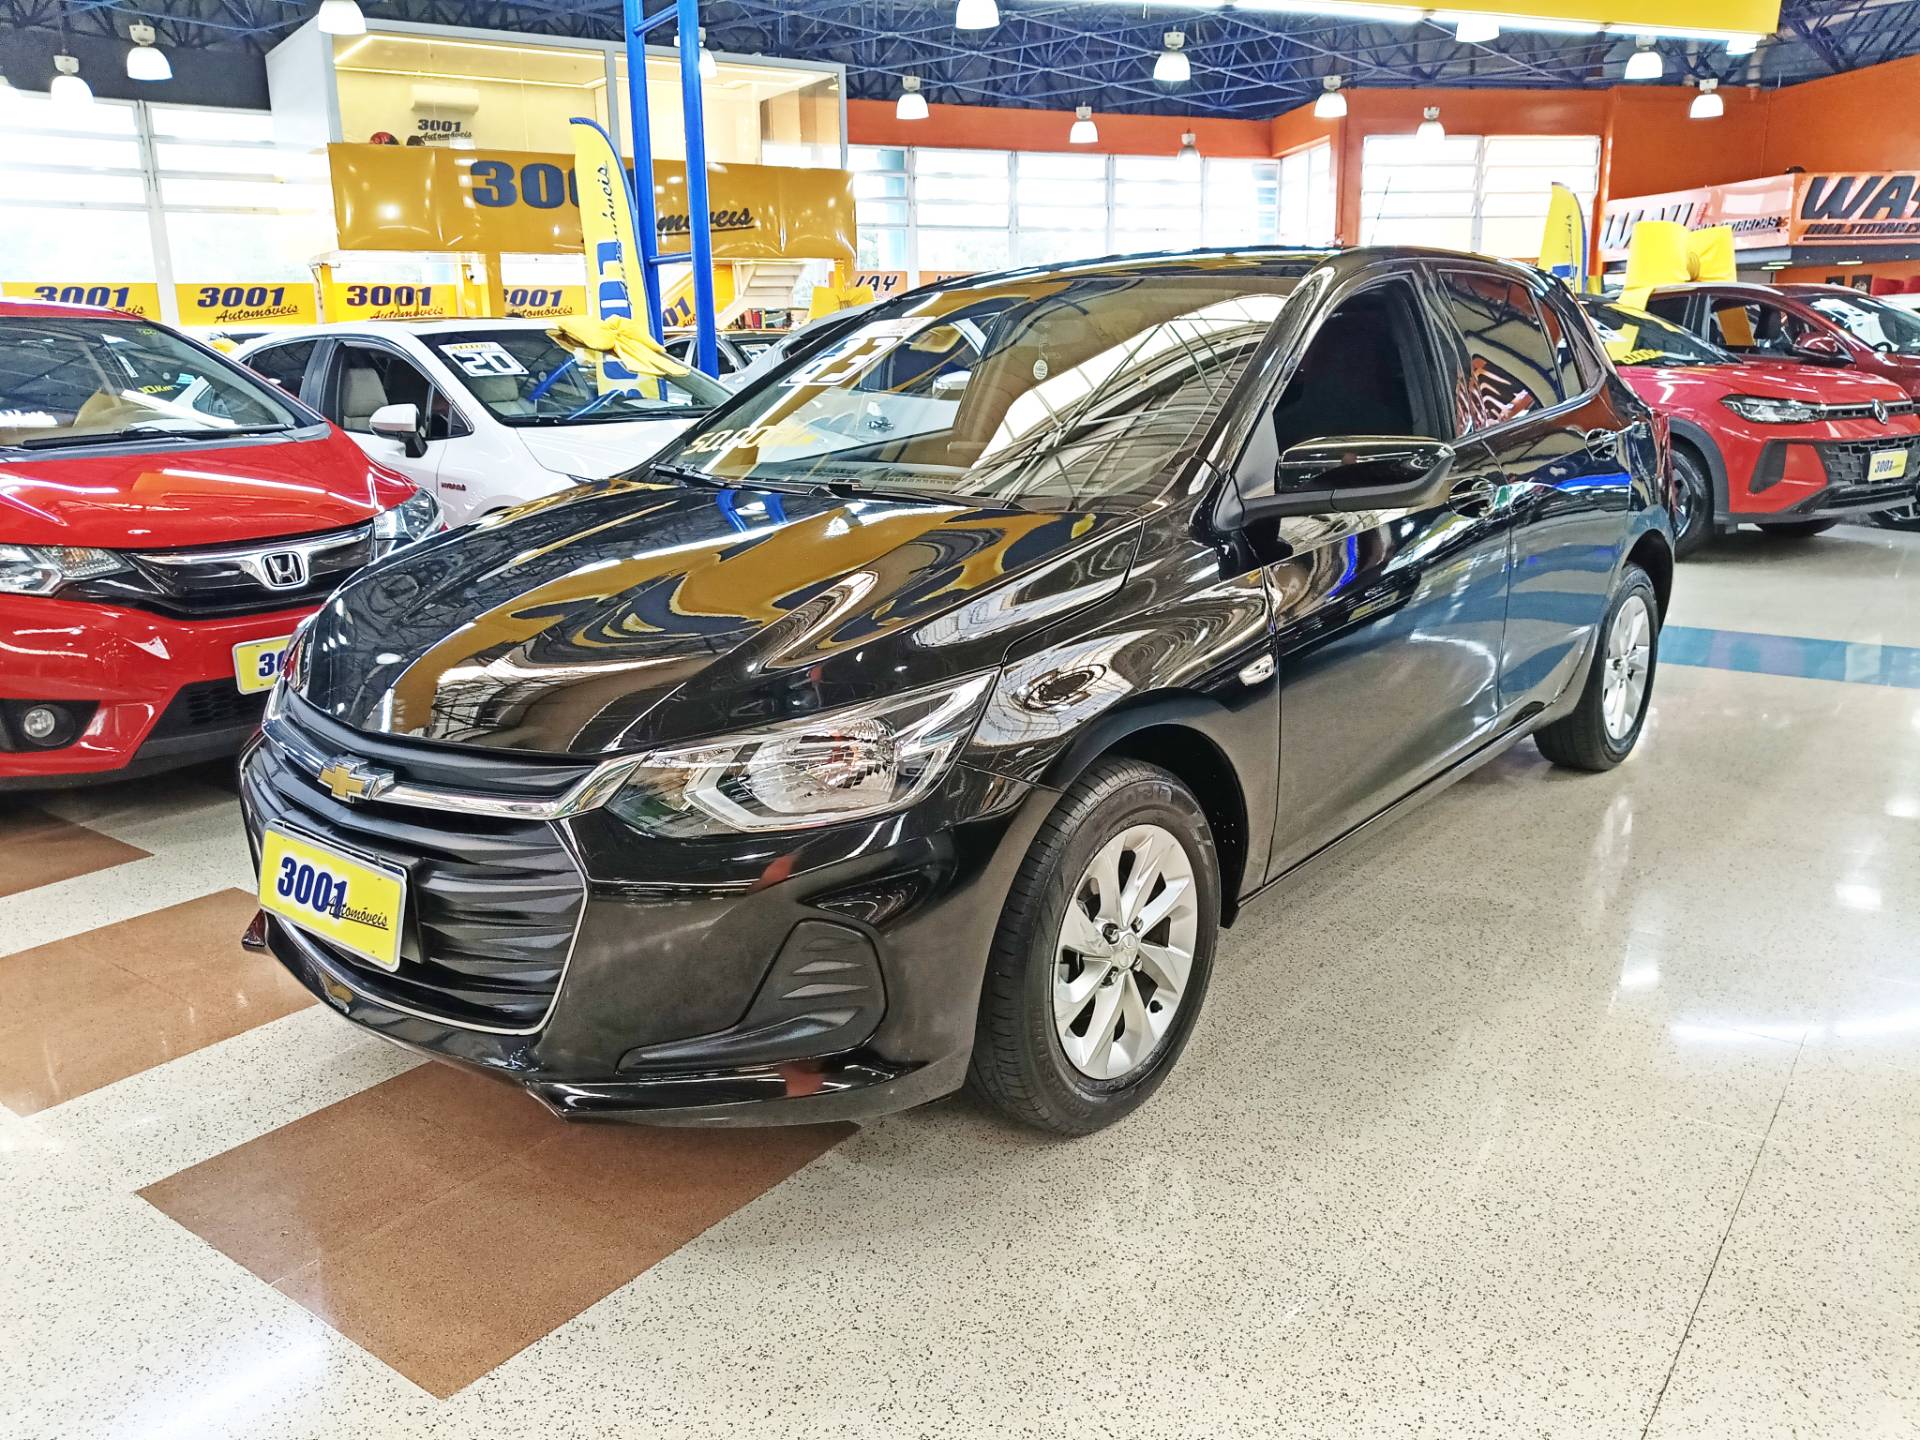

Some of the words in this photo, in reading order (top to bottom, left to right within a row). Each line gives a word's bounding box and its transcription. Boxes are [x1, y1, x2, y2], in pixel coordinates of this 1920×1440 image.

[418, 119, 461, 132] 3001
[1801, 175, 1920, 219] WA
[856, 275, 898, 291] AY
[197, 287, 285, 307] 3001
[346, 286, 432, 306] 3001
[215, 304, 299, 323] Automóveis
[662, 296, 691, 326] 01
[453, 352, 524, 374] 20
[277, 856, 347, 920] 3001
[328, 896, 389, 930] Automóveis
